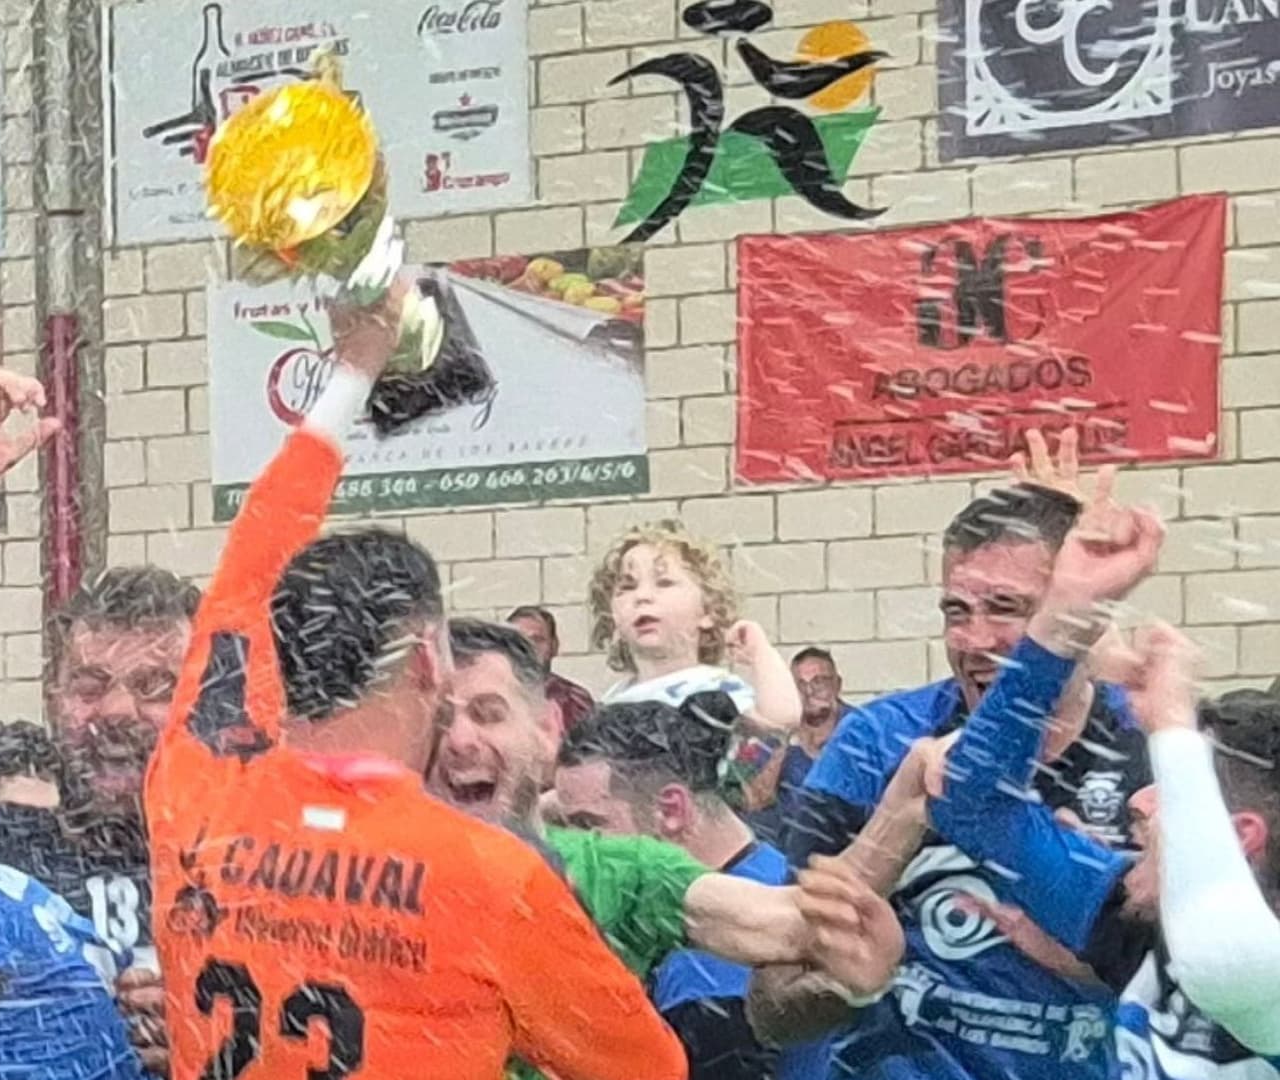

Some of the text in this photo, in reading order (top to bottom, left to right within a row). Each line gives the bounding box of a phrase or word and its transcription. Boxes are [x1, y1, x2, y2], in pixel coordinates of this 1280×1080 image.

[873, 356, 1092, 399] ABOGADOS
[86, 873, 140, 955] 13
[220, 836, 426, 916] CADAVAL
